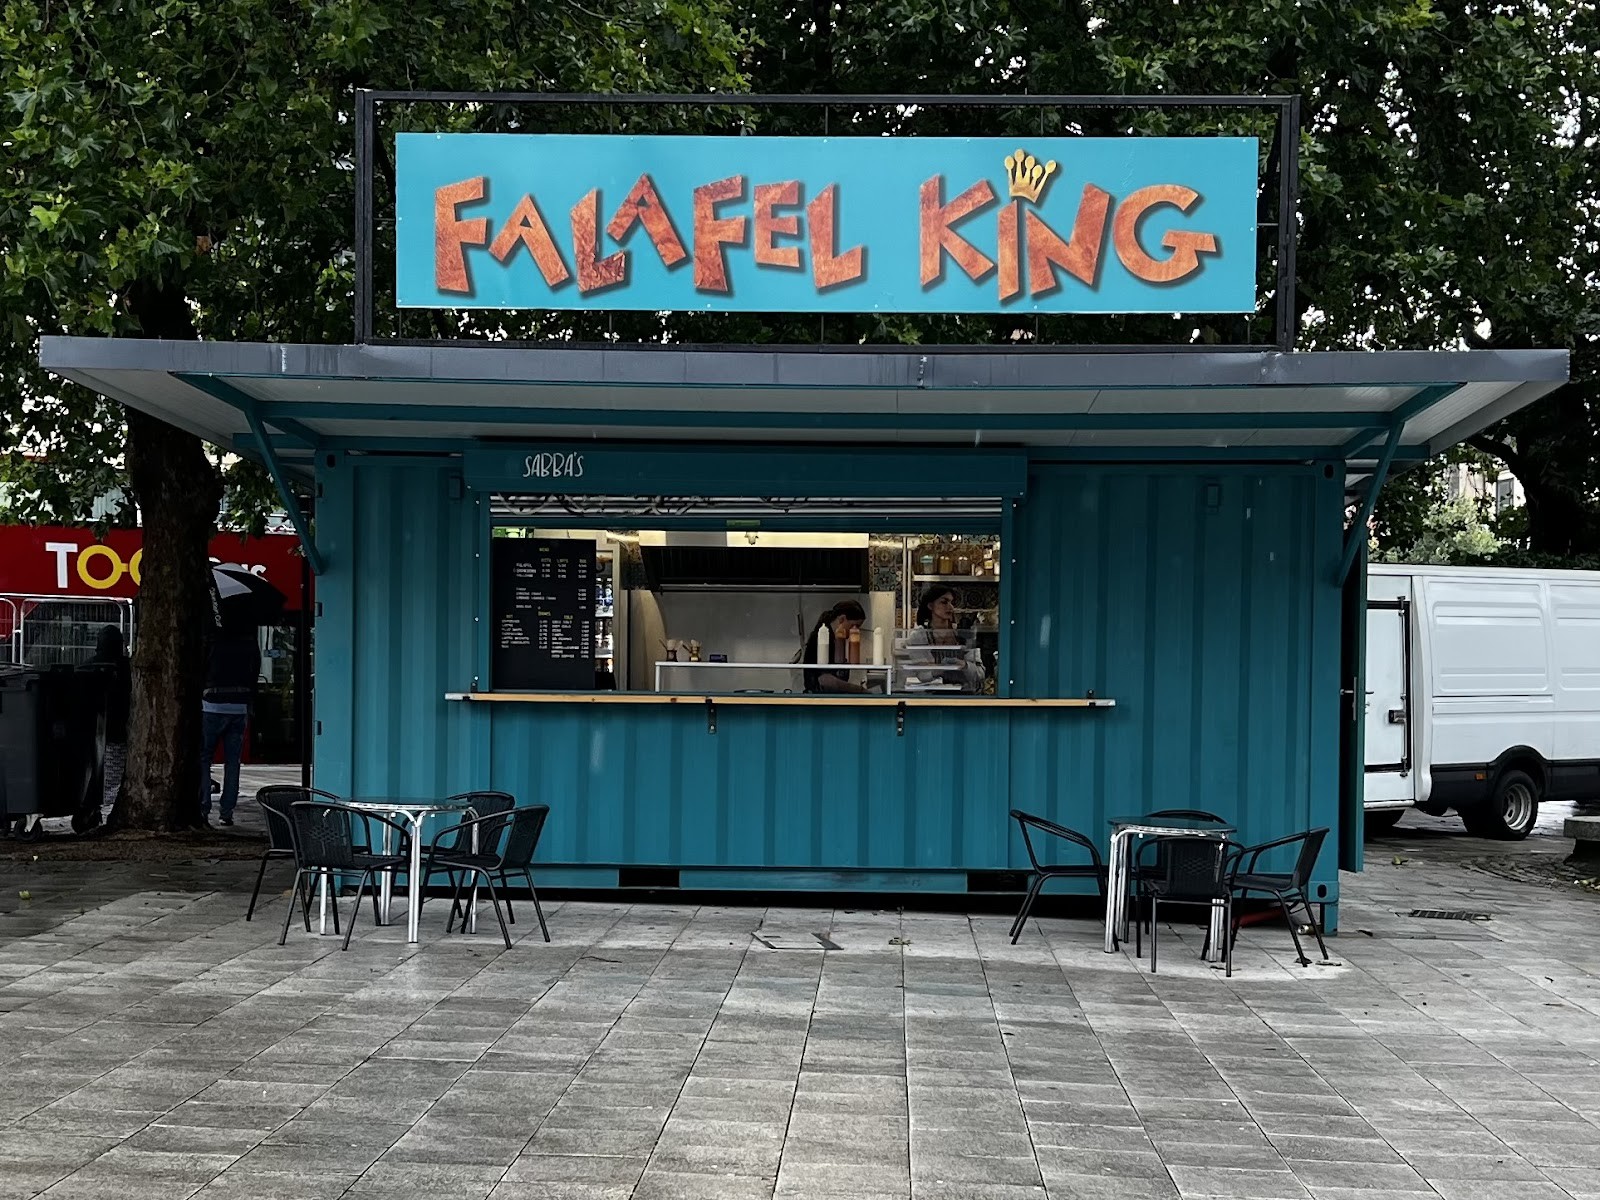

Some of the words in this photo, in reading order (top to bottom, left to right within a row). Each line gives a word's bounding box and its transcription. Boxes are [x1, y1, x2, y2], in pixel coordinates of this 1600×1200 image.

[434, 171, 865, 293] FALAFEL
[919, 160, 1217, 302] KING
[522, 452, 584, 477] SABBA'S
